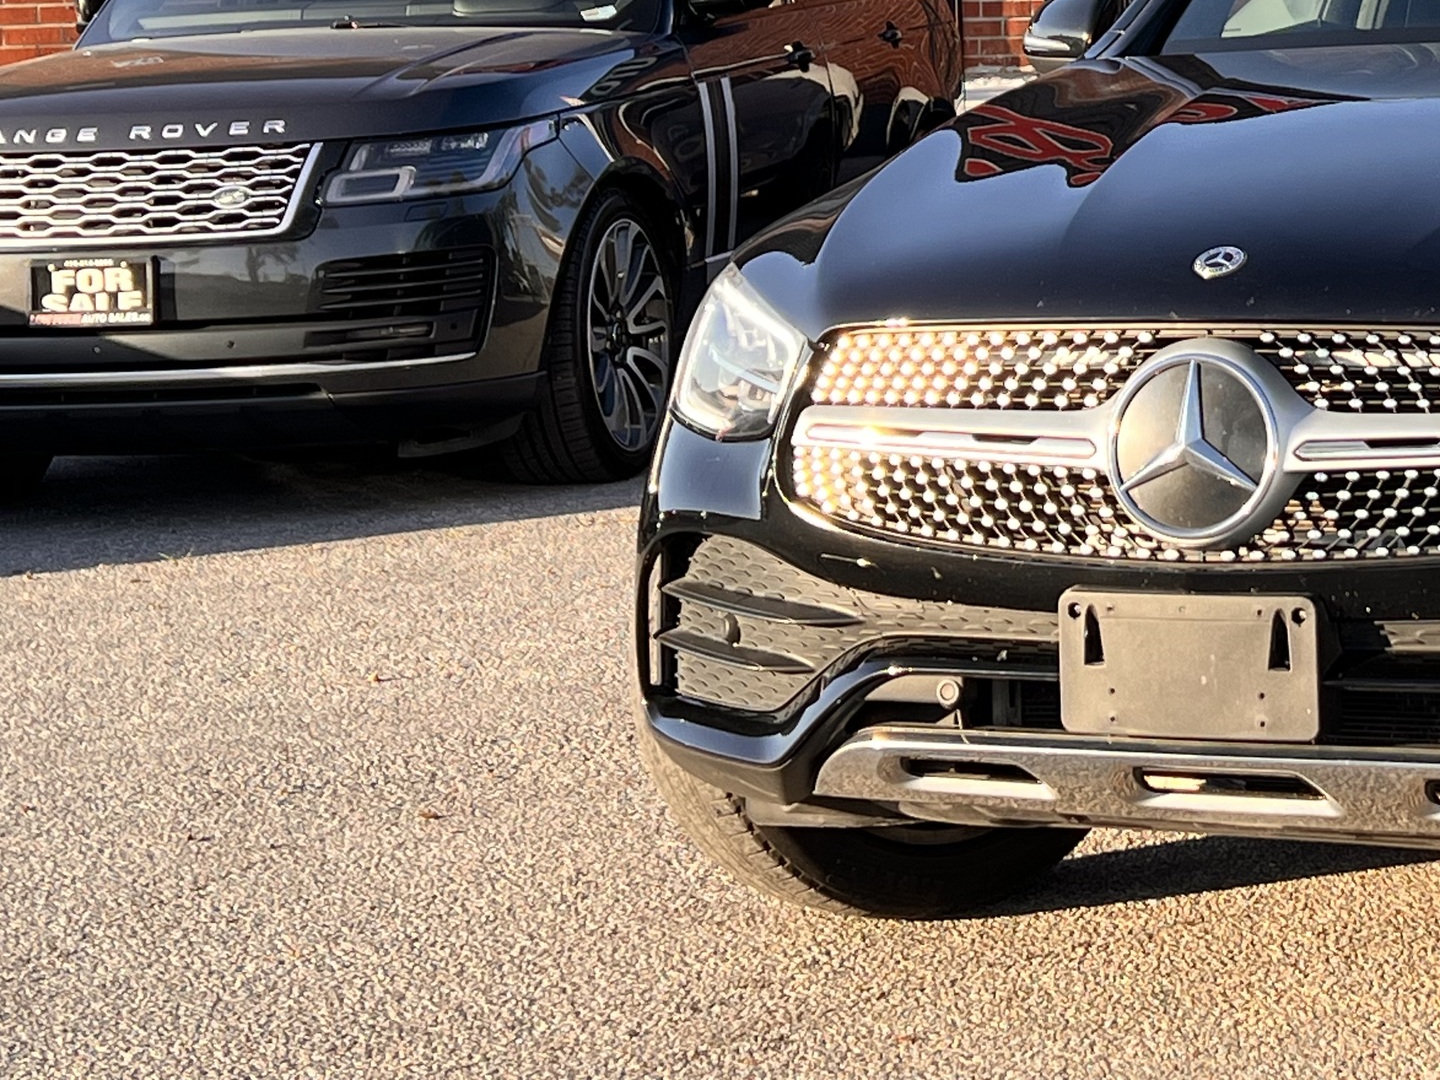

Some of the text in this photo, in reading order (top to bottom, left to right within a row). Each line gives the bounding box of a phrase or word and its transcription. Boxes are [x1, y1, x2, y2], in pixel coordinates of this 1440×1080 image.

[129, 120, 286, 140] ROVER
[51, 267, 133, 294] FOR
[41, 291, 142, 312] SALE
